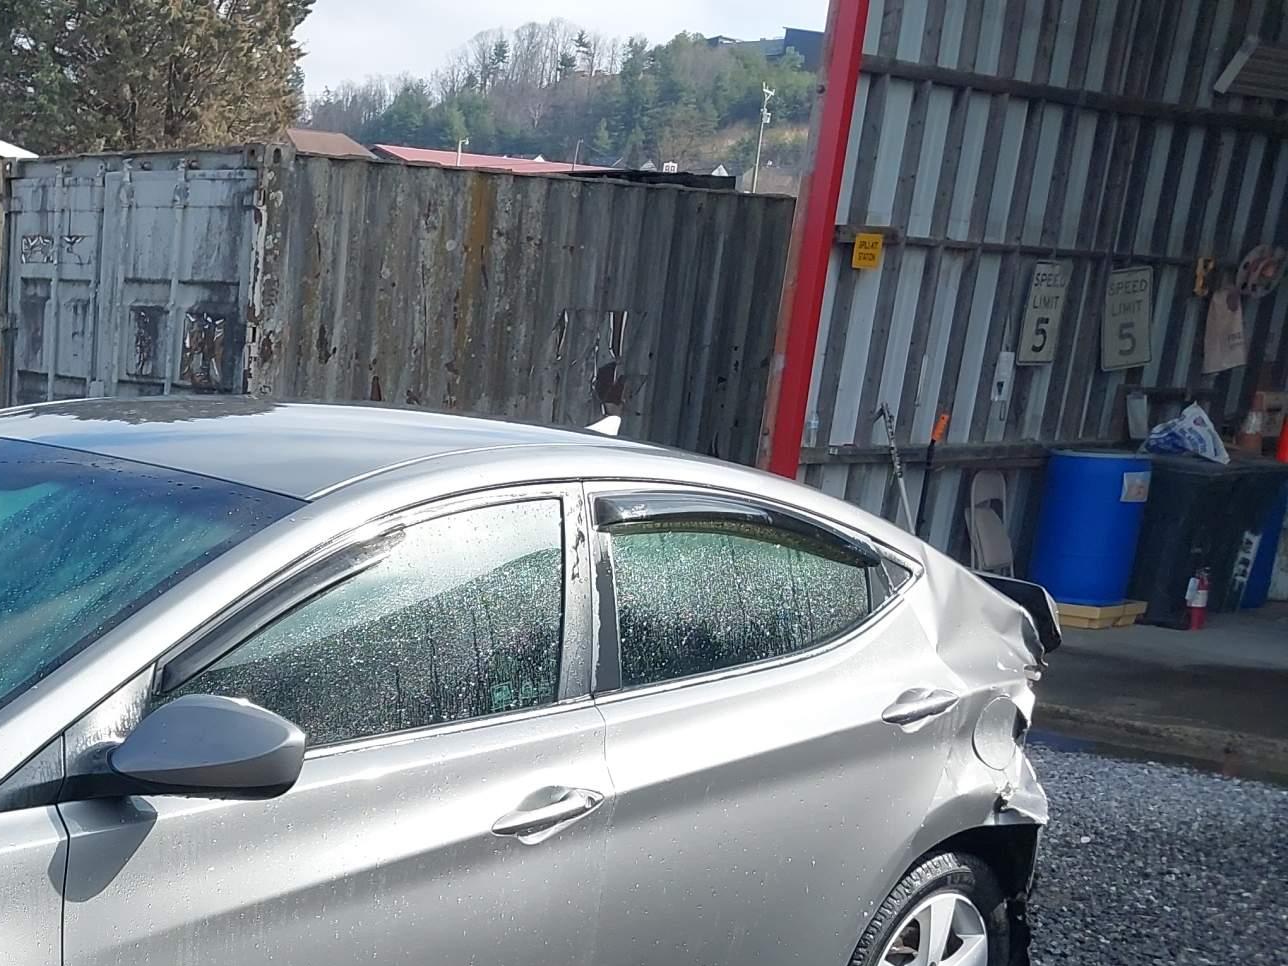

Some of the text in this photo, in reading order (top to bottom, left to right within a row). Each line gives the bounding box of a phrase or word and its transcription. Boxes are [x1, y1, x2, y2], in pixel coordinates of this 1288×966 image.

[1033, 272, 1066, 289] SPEED
[1107, 278, 1149, 297] SPEED
[1032, 295, 1061, 310] LIMIT
[1111, 299, 1144, 318] LIMIT
[1031, 316, 1051, 353] 5
[1117, 321, 1137, 357] 5
